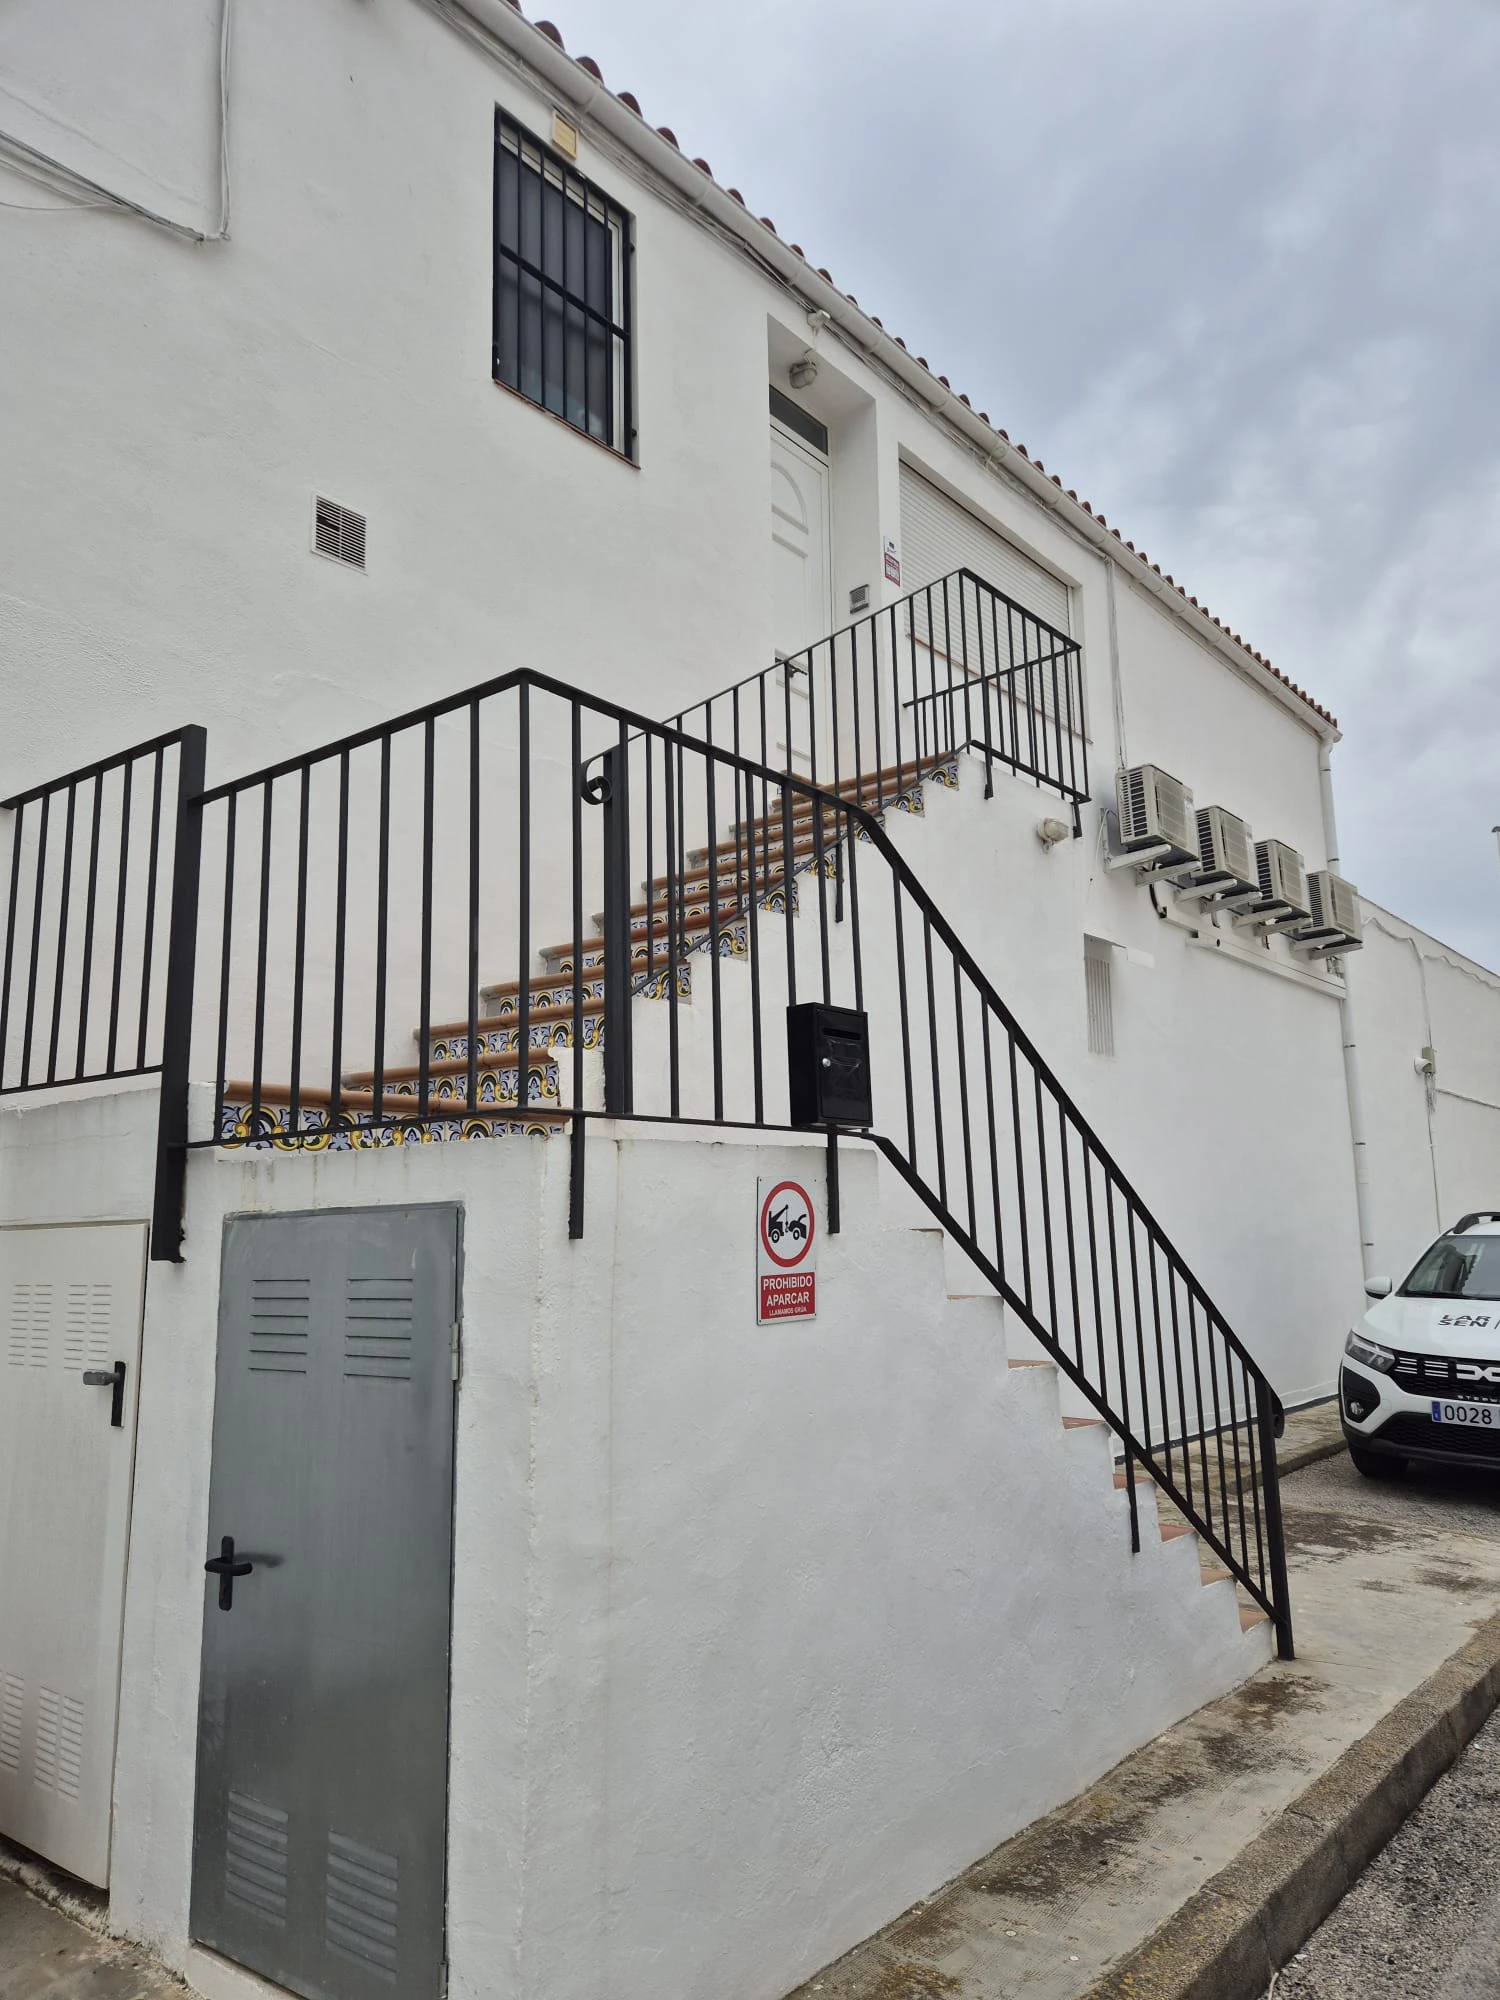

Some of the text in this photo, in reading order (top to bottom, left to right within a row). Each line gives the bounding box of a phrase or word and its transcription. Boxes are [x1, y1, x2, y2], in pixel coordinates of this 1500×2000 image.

[763, 1276, 813, 1291] PROHIBIDO
[766, 1291, 810, 1307] APARCAR
[1437, 1319, 1488, 1327] SEN
[1444, 1404, 1493, 1425] 0028
